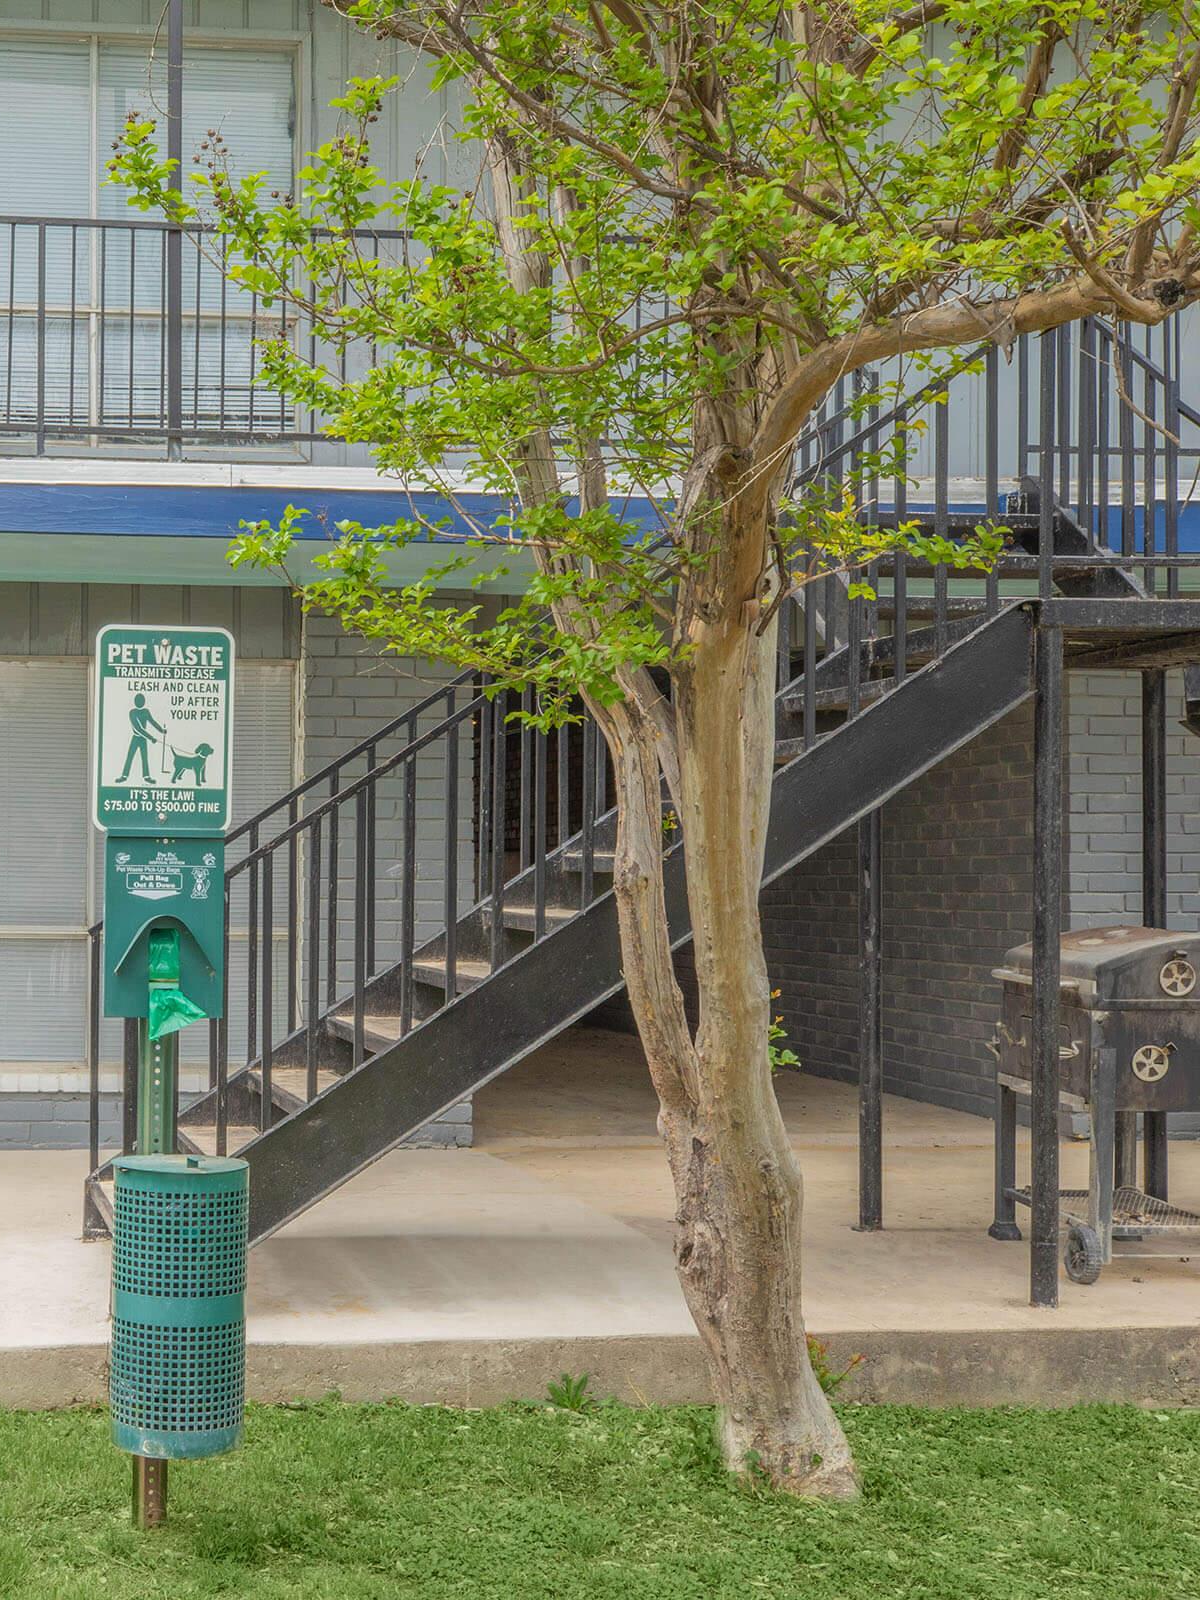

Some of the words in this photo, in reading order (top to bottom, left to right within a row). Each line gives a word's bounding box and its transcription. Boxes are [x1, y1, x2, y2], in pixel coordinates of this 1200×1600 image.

[108, 643, 147, 663] PET
[153, 644, 223, 666] WASTE
[114, 666, 171, 678] TRANSMITS
[174, 668, 215, 680] DISEASE
[128, 681, 160, 692] LEASH
[163, 682, 184, 692] AND
[187, 682, 219, 693] CLEAN
[171, 696, 185, 706] UP
[187, 696, 219, 707] AFTER
[170, 710, 197, 720] YOUR
[200, 710, 219, 721] PET
[130, 789, 148, 800] IT'S
[151, 790, 169, 800] THE
[171, 790, 195, 801] LAW!
[104, 799, 138, 811] $75.00
[140, 801, 153, 811] TO
[155, 801, 196, 812] $500.00
[198, 802, 220, 813] FINE
